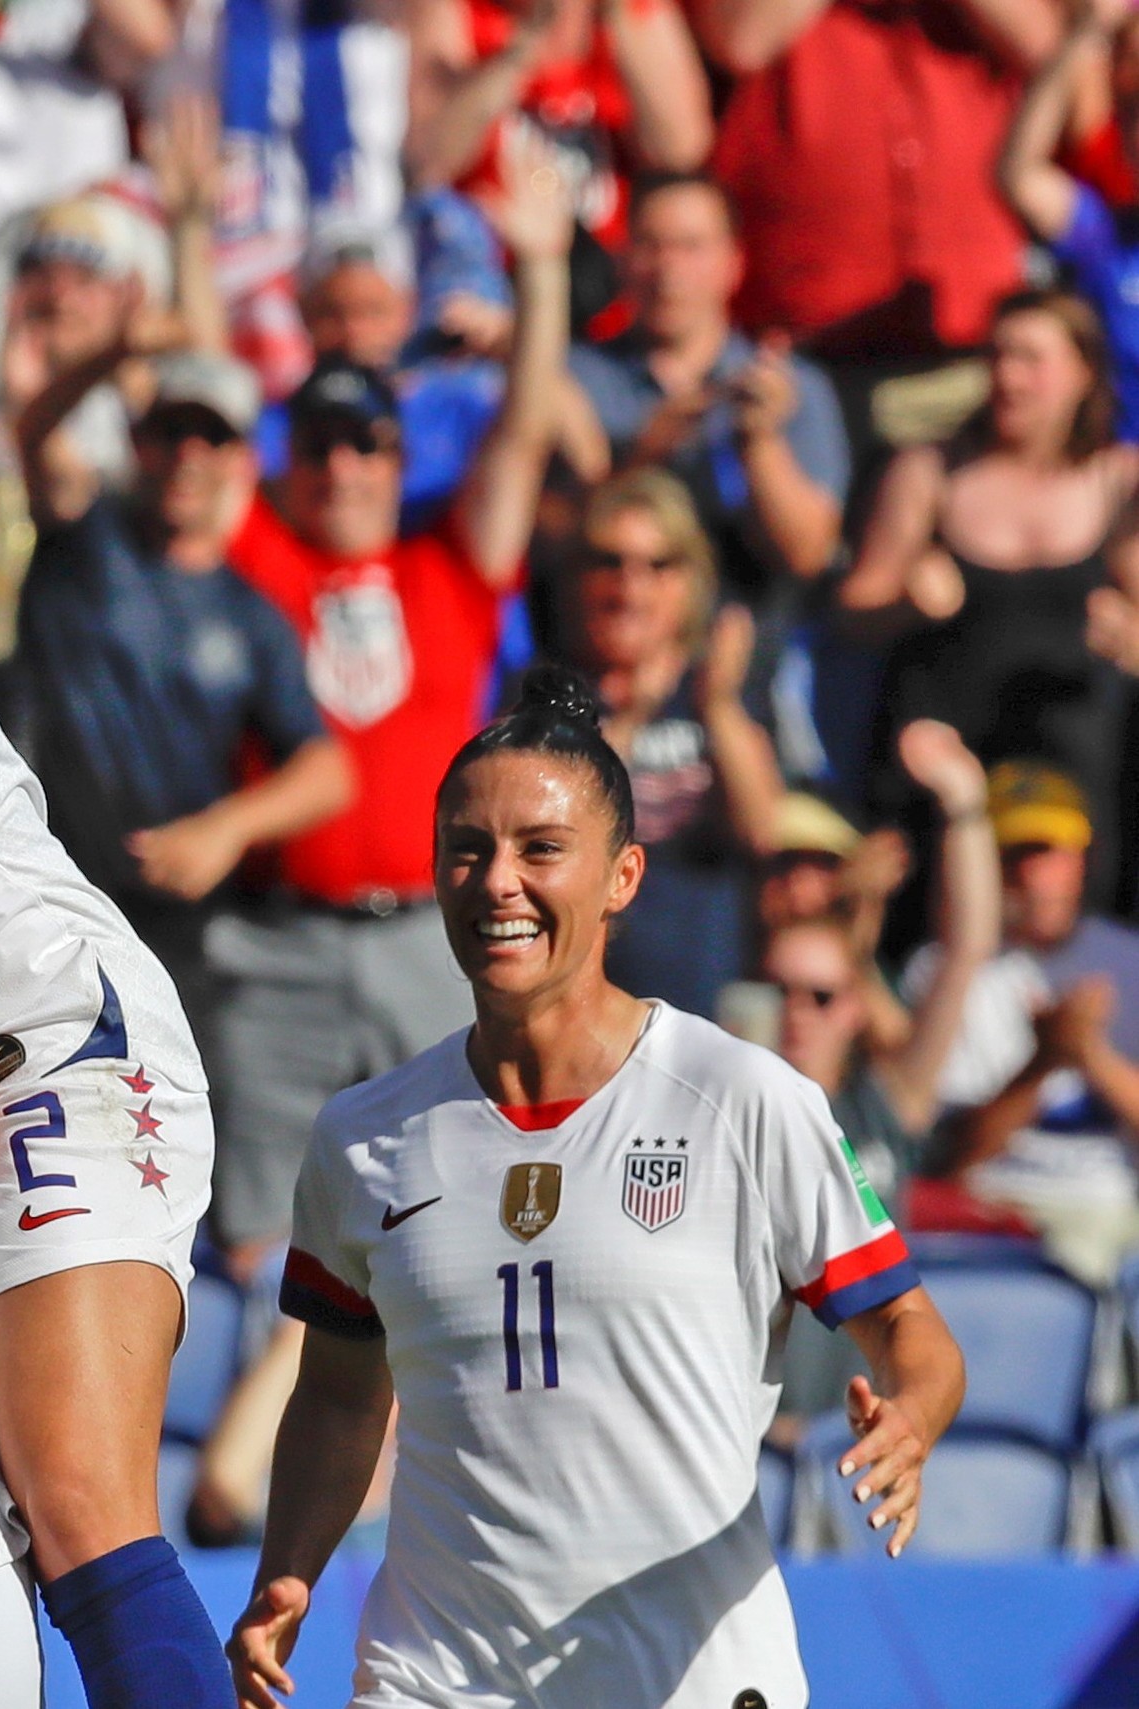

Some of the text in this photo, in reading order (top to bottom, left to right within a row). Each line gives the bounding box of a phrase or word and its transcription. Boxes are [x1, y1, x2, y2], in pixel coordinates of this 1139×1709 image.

[2, 1090, 77, 1194] 2
[631, 1159, 682, 1188] USA
[497, 1260, 559, 1391] 11
